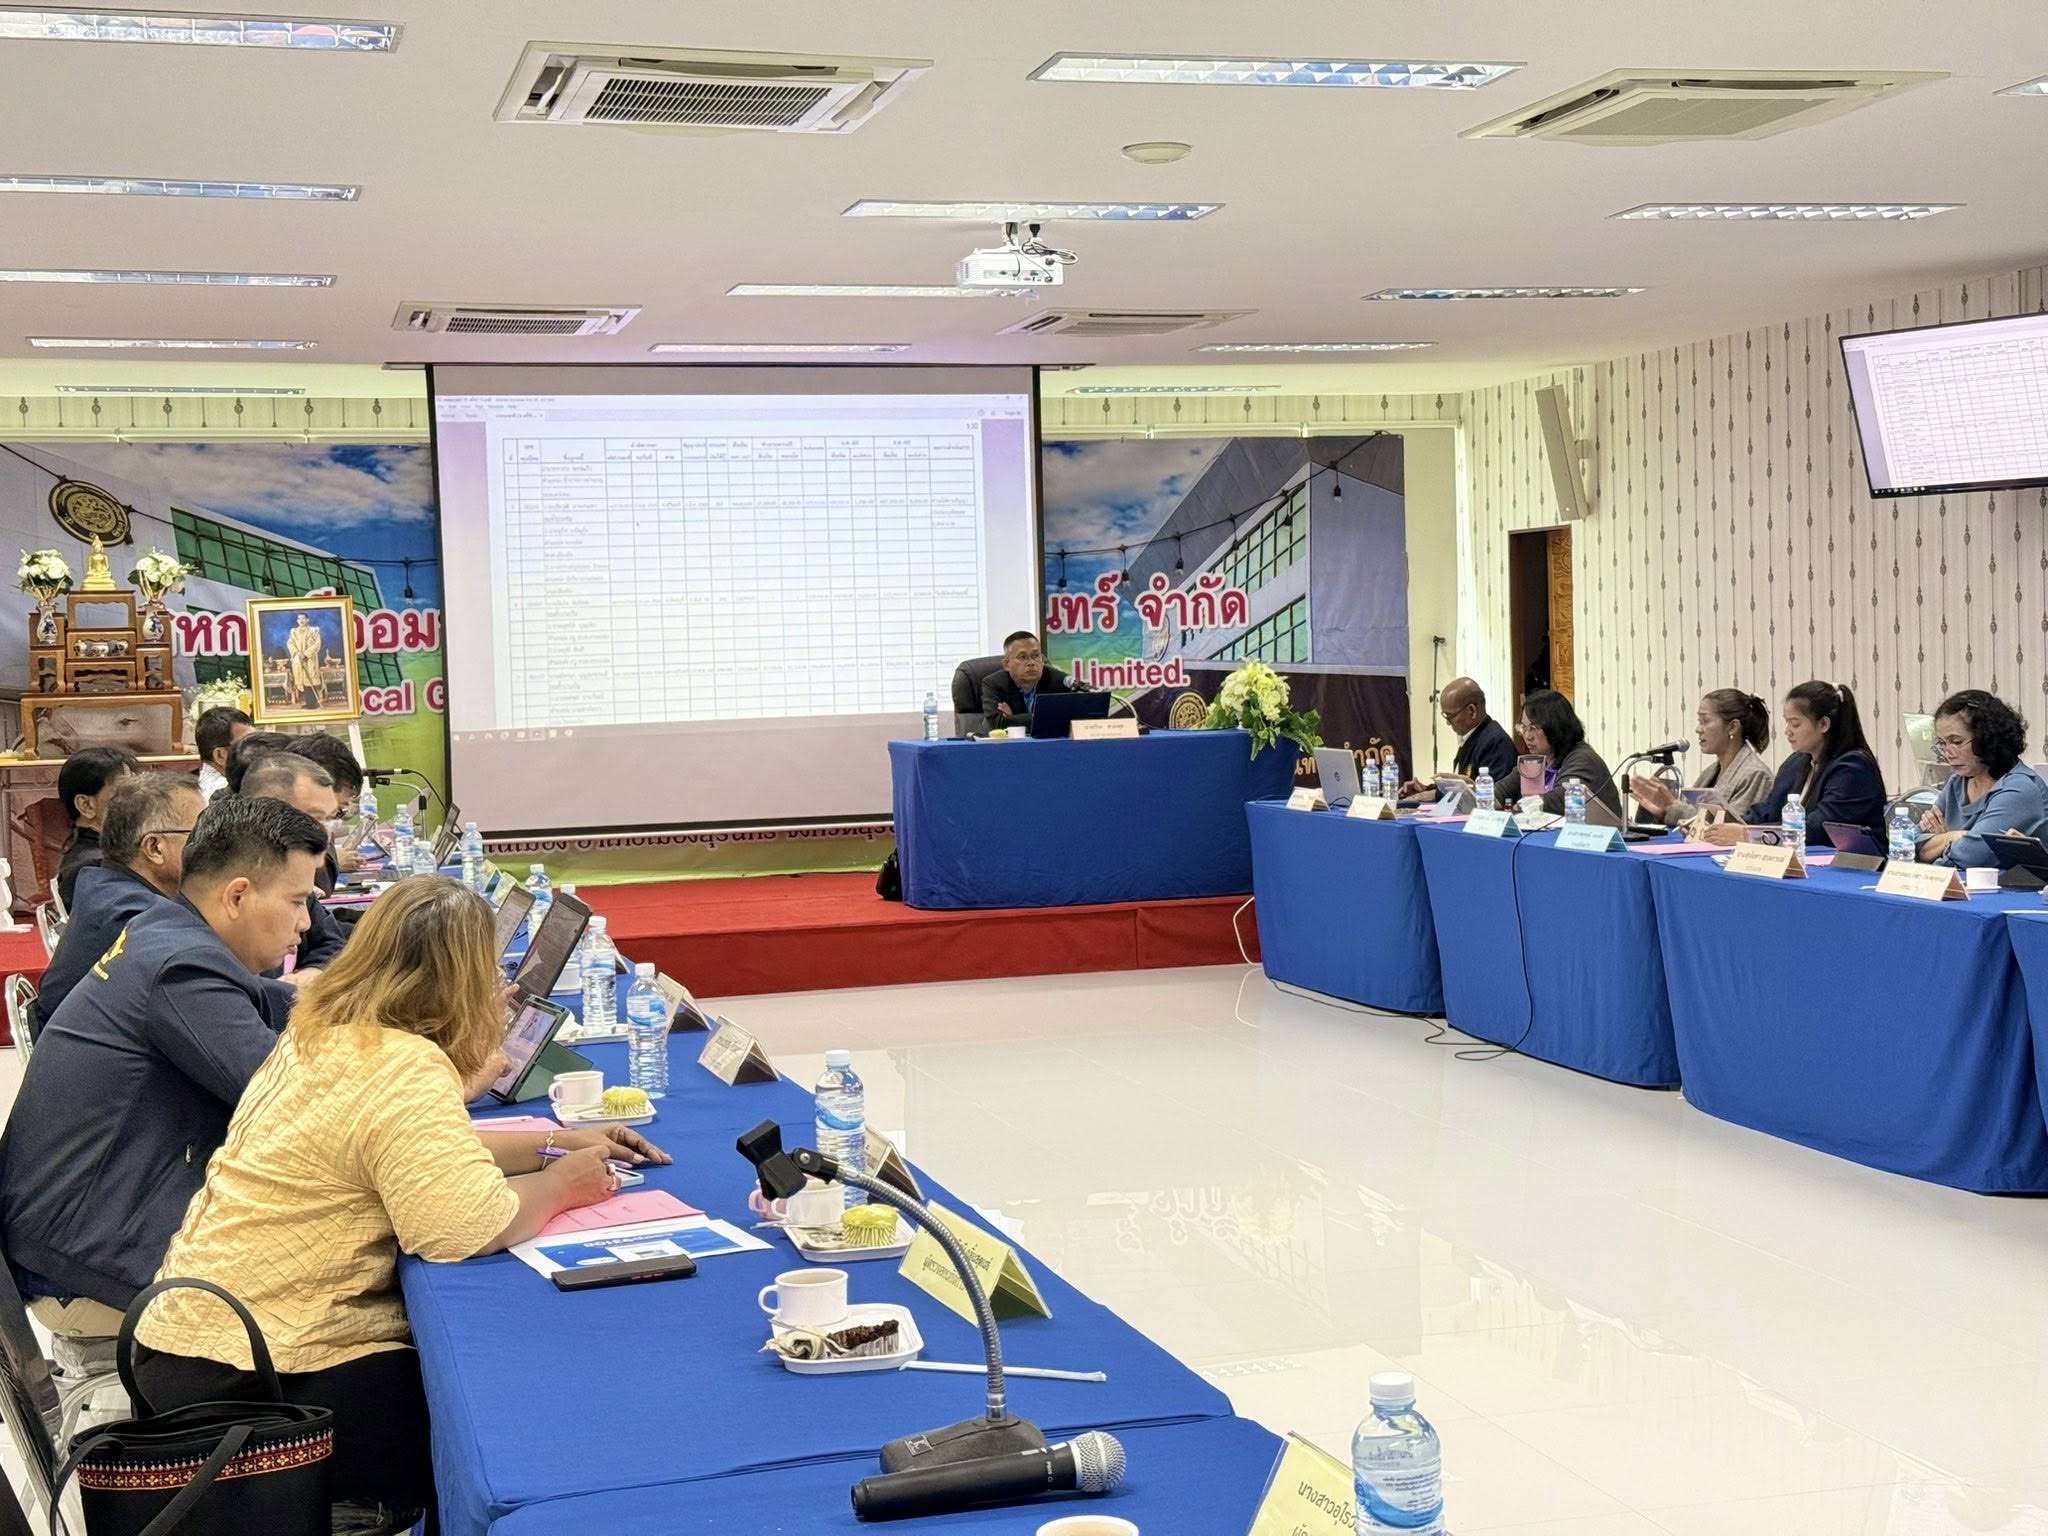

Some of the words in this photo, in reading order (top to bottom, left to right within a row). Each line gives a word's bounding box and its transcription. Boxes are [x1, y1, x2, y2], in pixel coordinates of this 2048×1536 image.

[1138, 575, 1247, 628] จำกัด
[1074, 657, 1188, 688] Limited.
[360, 682, 412, 713] cal
[1298, 1481, 1358, 1532] นางสาวอุไรว
